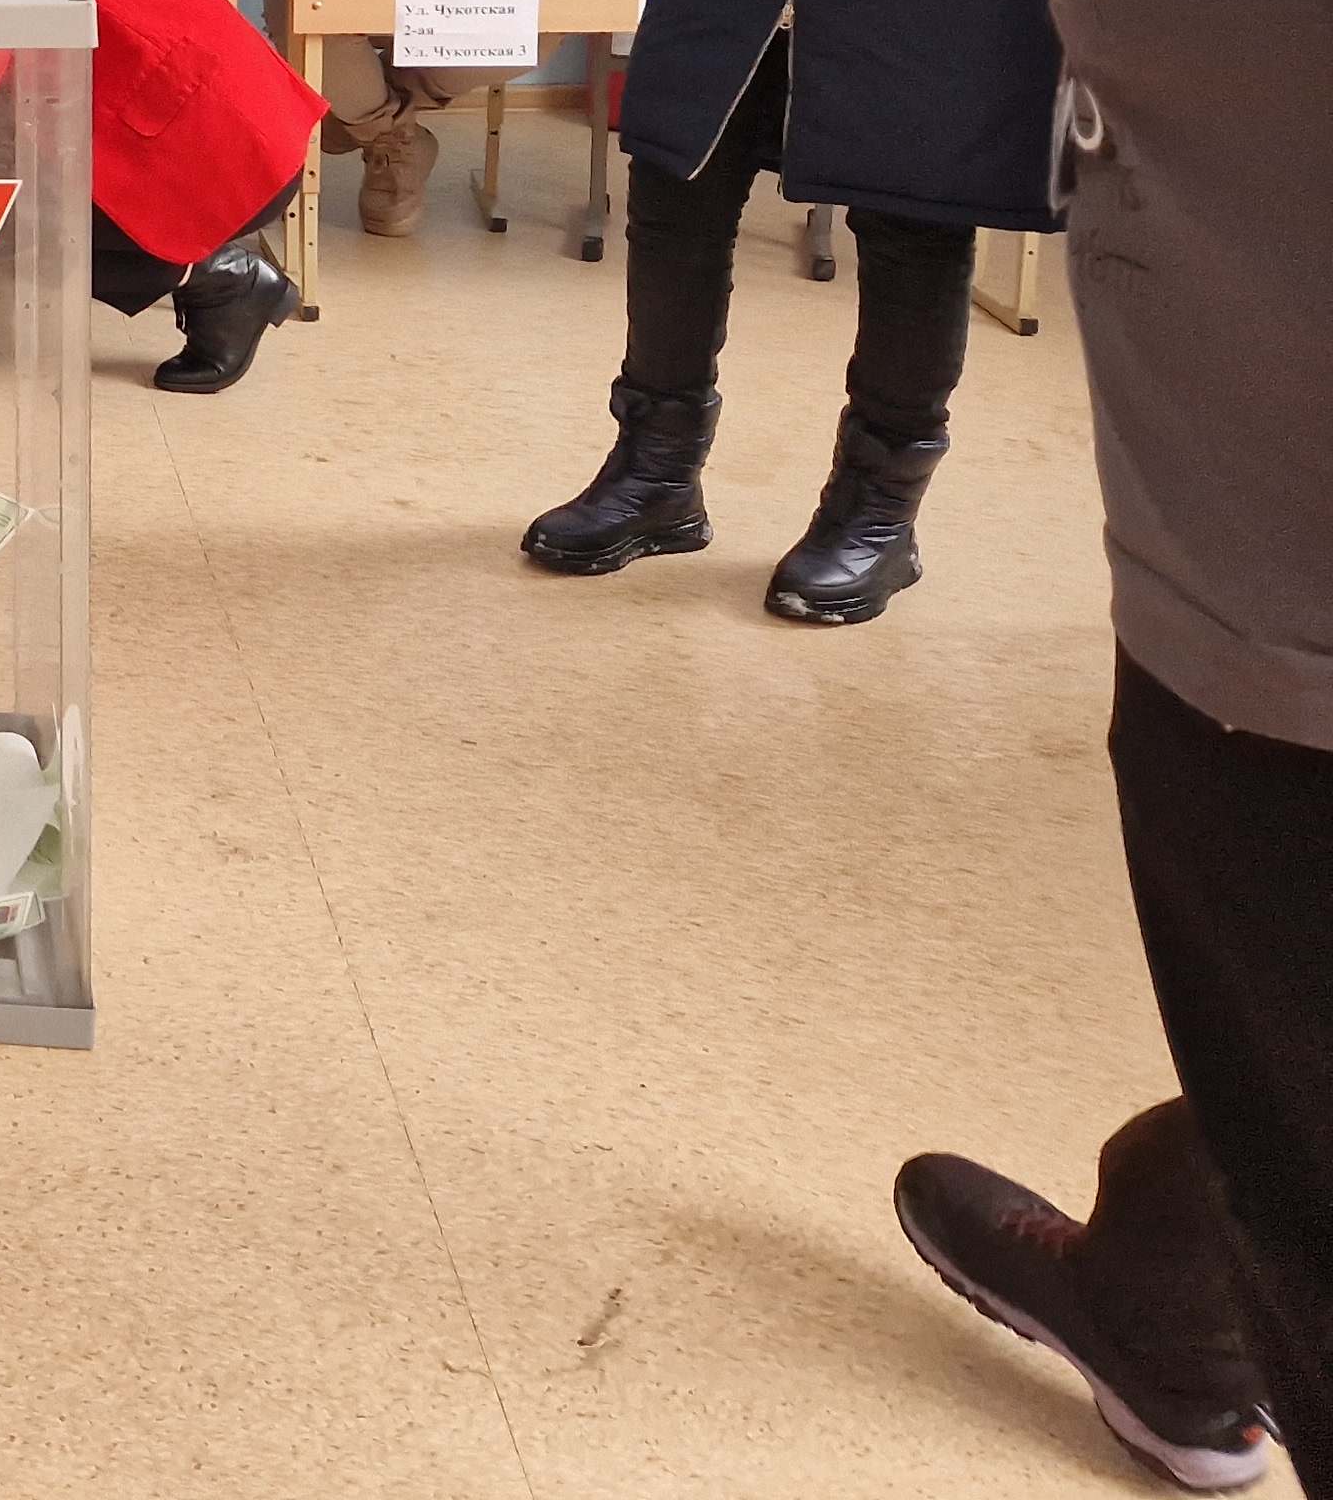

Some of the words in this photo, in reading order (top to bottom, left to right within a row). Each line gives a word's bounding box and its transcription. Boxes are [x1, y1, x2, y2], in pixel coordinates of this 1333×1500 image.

[404, 5, 429, 16] Ул.
[434, 4, 515, 18] Чукотская
[404, 25, 434, 36] 2-ая
[404, 46, 428, 58] Ул.
[433, 45, 514, 60] Чукотская
[518, 44, 527, 57] 3
